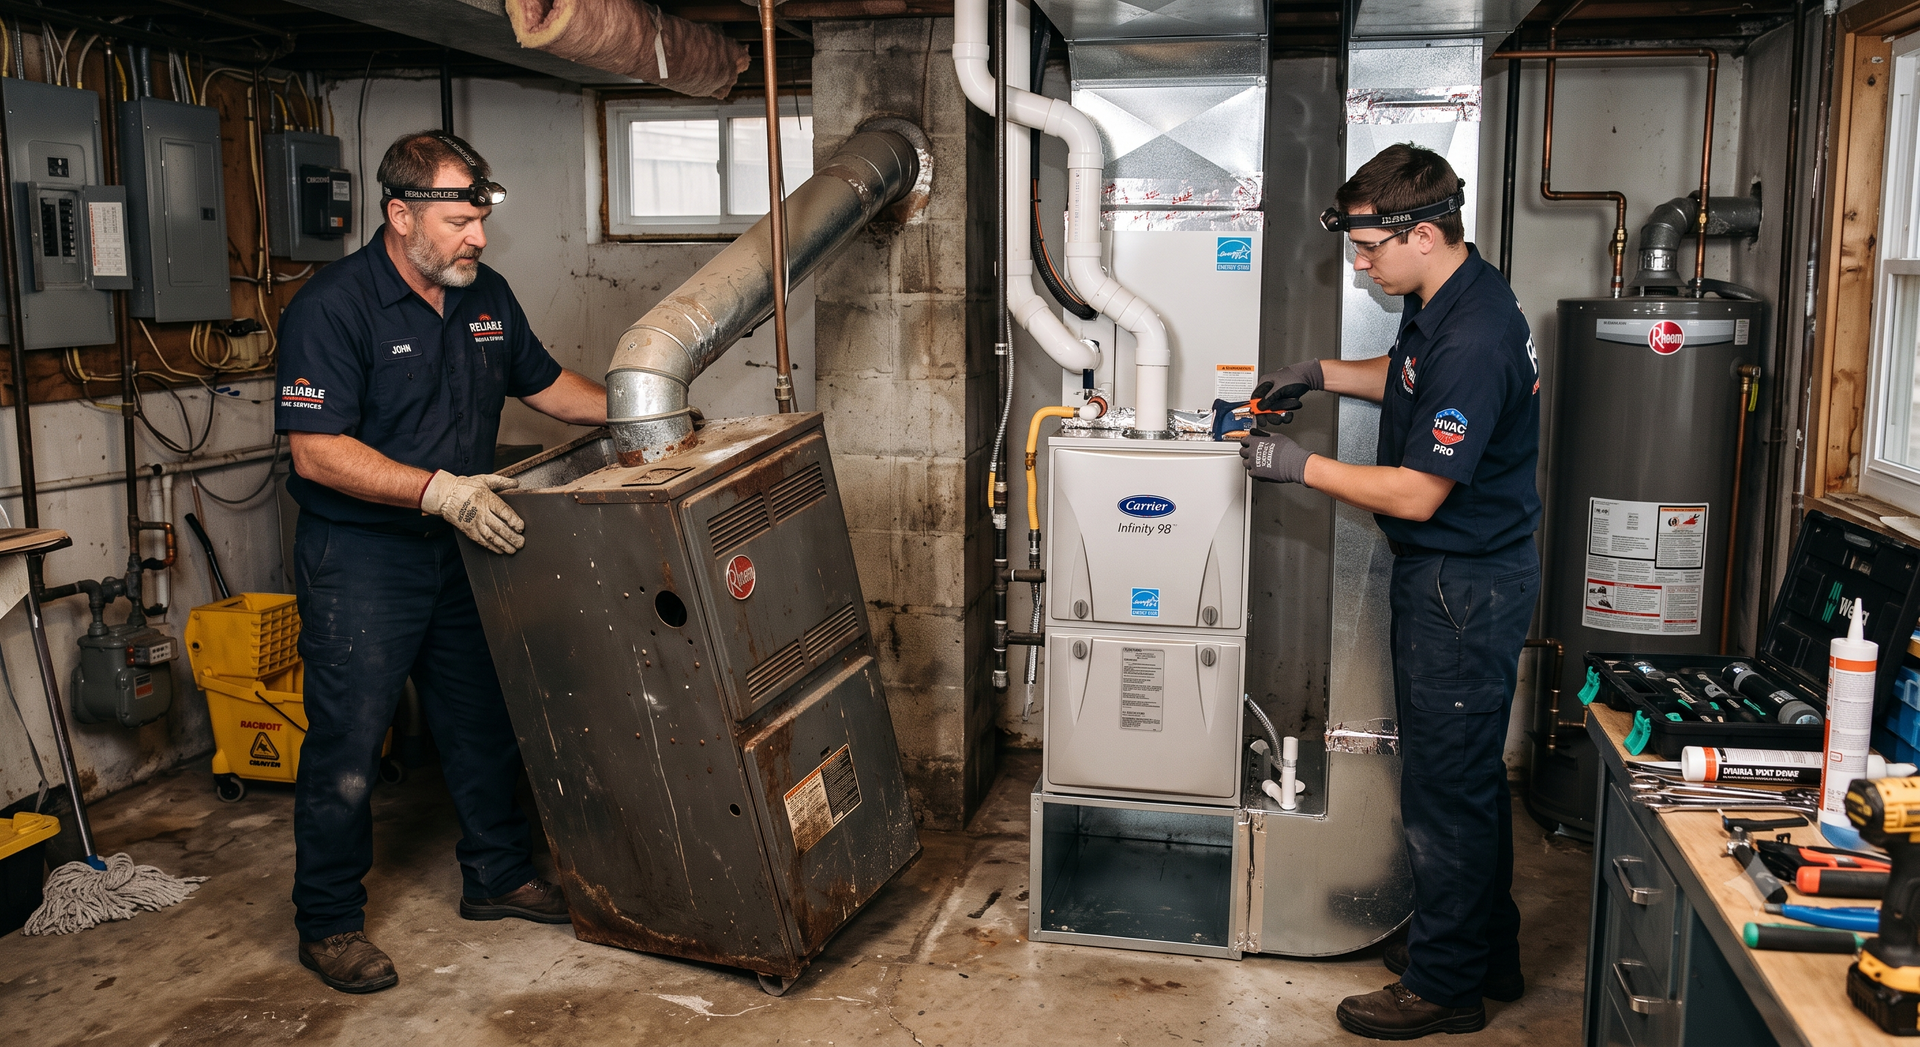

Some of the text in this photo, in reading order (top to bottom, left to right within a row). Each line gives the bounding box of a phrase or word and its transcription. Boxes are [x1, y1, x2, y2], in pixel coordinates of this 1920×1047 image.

[1651, 322, 1683, 349] Rheem
[391, 343, 412, 355] JOHN
[292, 401, 322, 410] SERVICES
[1434, 418, 1467, 435] HVAC
[1432, 443, 1454, 456] PRO
[1126, 500, 1168, 511] Carrier
[1118, 522, 1172, 536] Infinity 98
[1839, 596, 1870, 627] Wea
